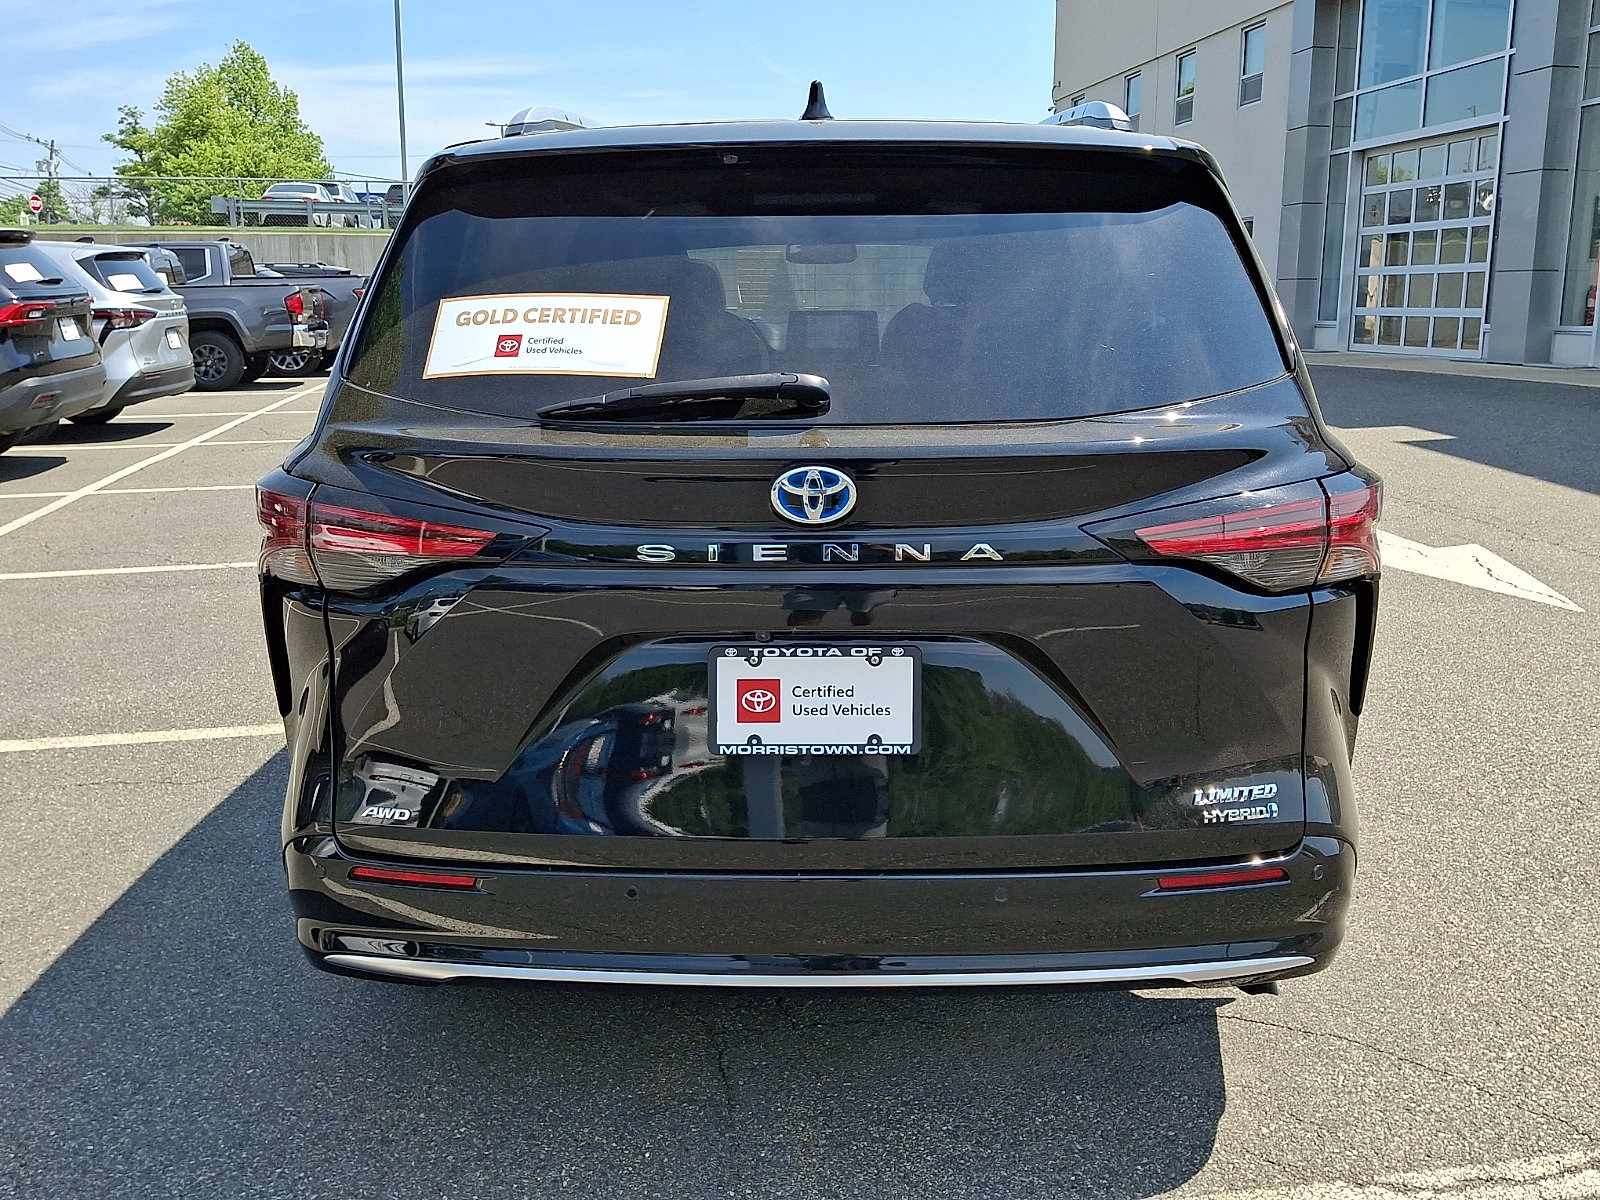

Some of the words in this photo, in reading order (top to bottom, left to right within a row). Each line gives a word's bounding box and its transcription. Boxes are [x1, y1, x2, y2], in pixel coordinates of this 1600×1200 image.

[455, 308, 518, 327] GOLD
[522, 307, 642, 326] CERTIFIED
[527, 336, 564, 345] Certified
[525, 346, 548, 355] Used
[549, 346, 583, 355] Vehicles
[636, 543, 1004, 562] SIENNA
[748, 647, 843, 657] TOYOTA
[850, 647, 883, 657] OF
[791, 685, 855, 698] Certified
[792, 703, 829, 716] Used
[832, 703, 892, 716] Vehicles
[719, 745, 911, 755] MORRISTOWN.COM
[1192, 784, 1278, 806] LIMITED
[361, 806, 411, 821] AWD
[1202, 806, 1269, 824] HYBRID
